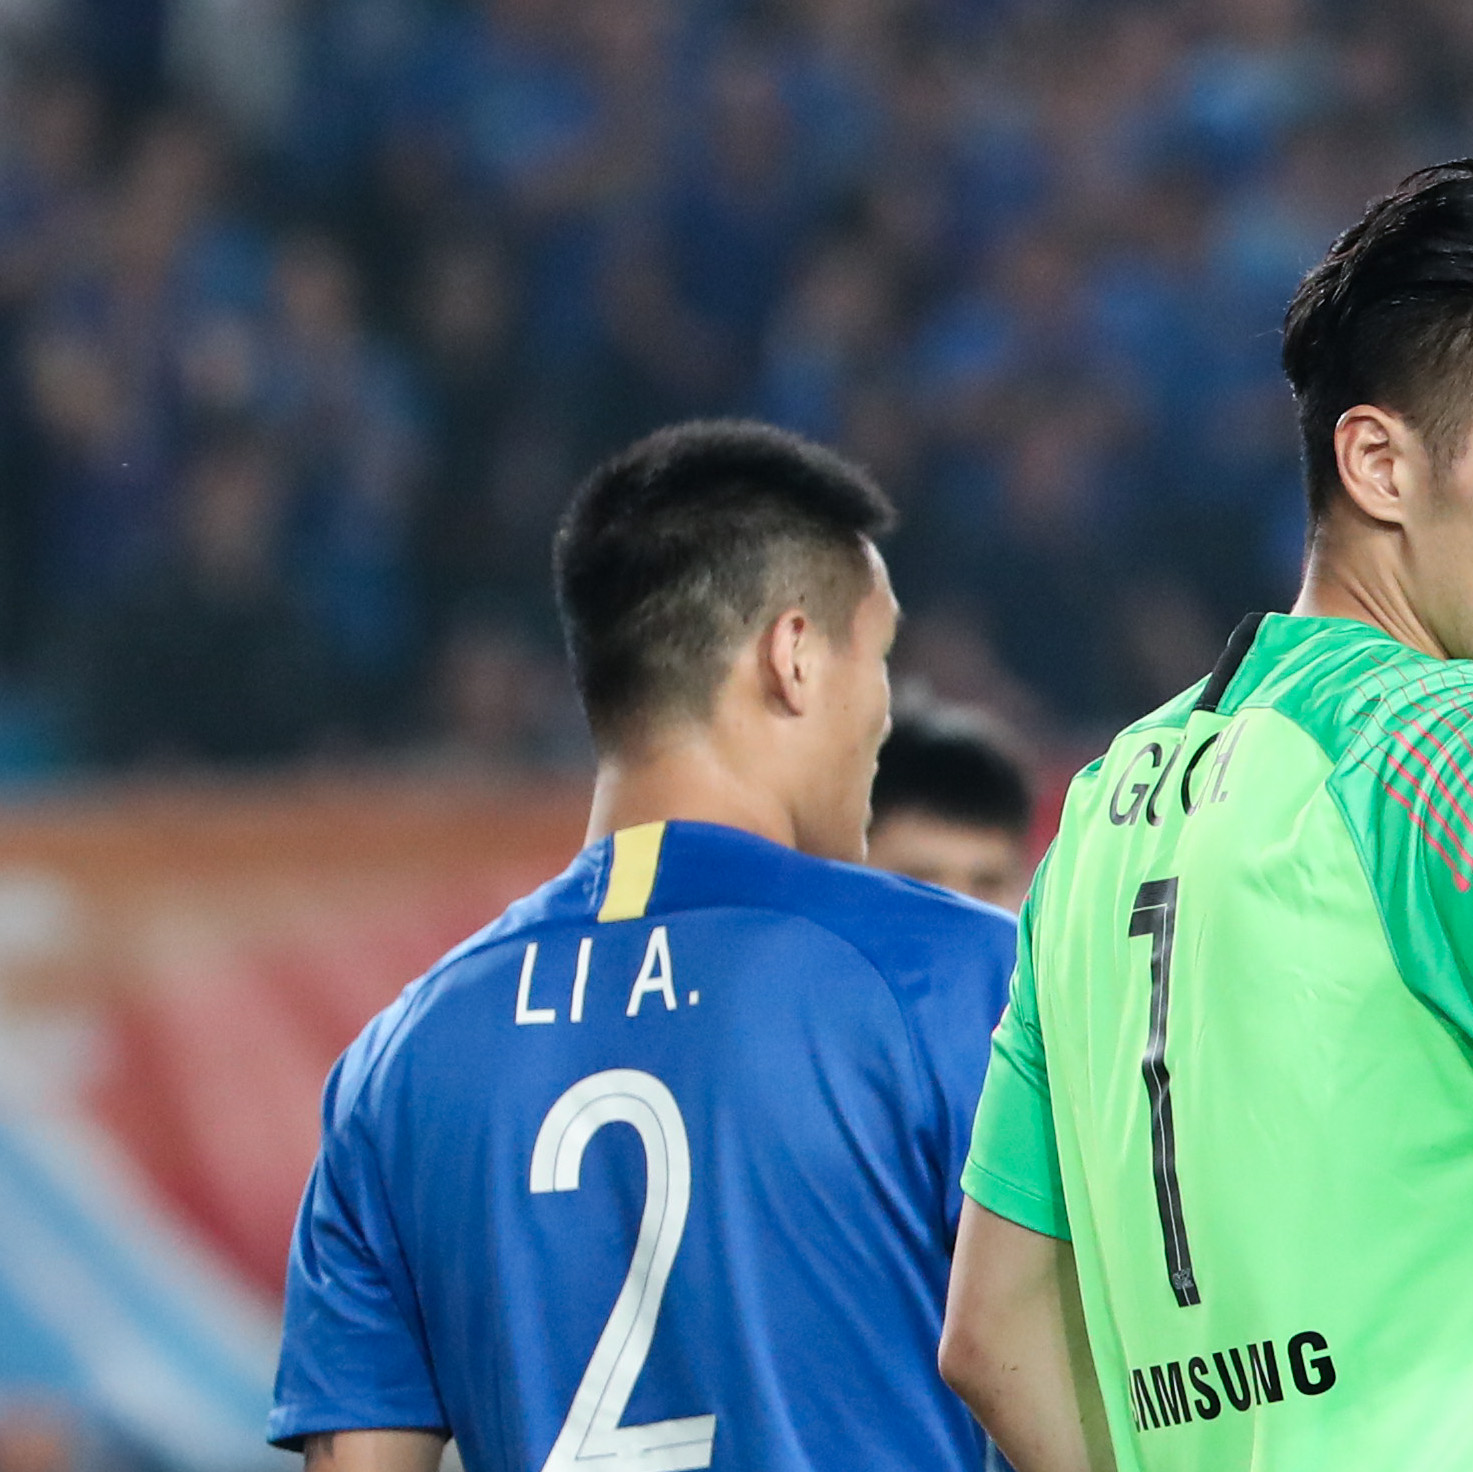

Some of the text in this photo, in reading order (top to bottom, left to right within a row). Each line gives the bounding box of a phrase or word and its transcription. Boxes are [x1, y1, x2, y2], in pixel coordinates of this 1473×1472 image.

[514, 925, 699, 1025] LI A.
[1128, 876, 1201, 1308] 1
[1130, 1330, 1337, 1433] AMSUNG
